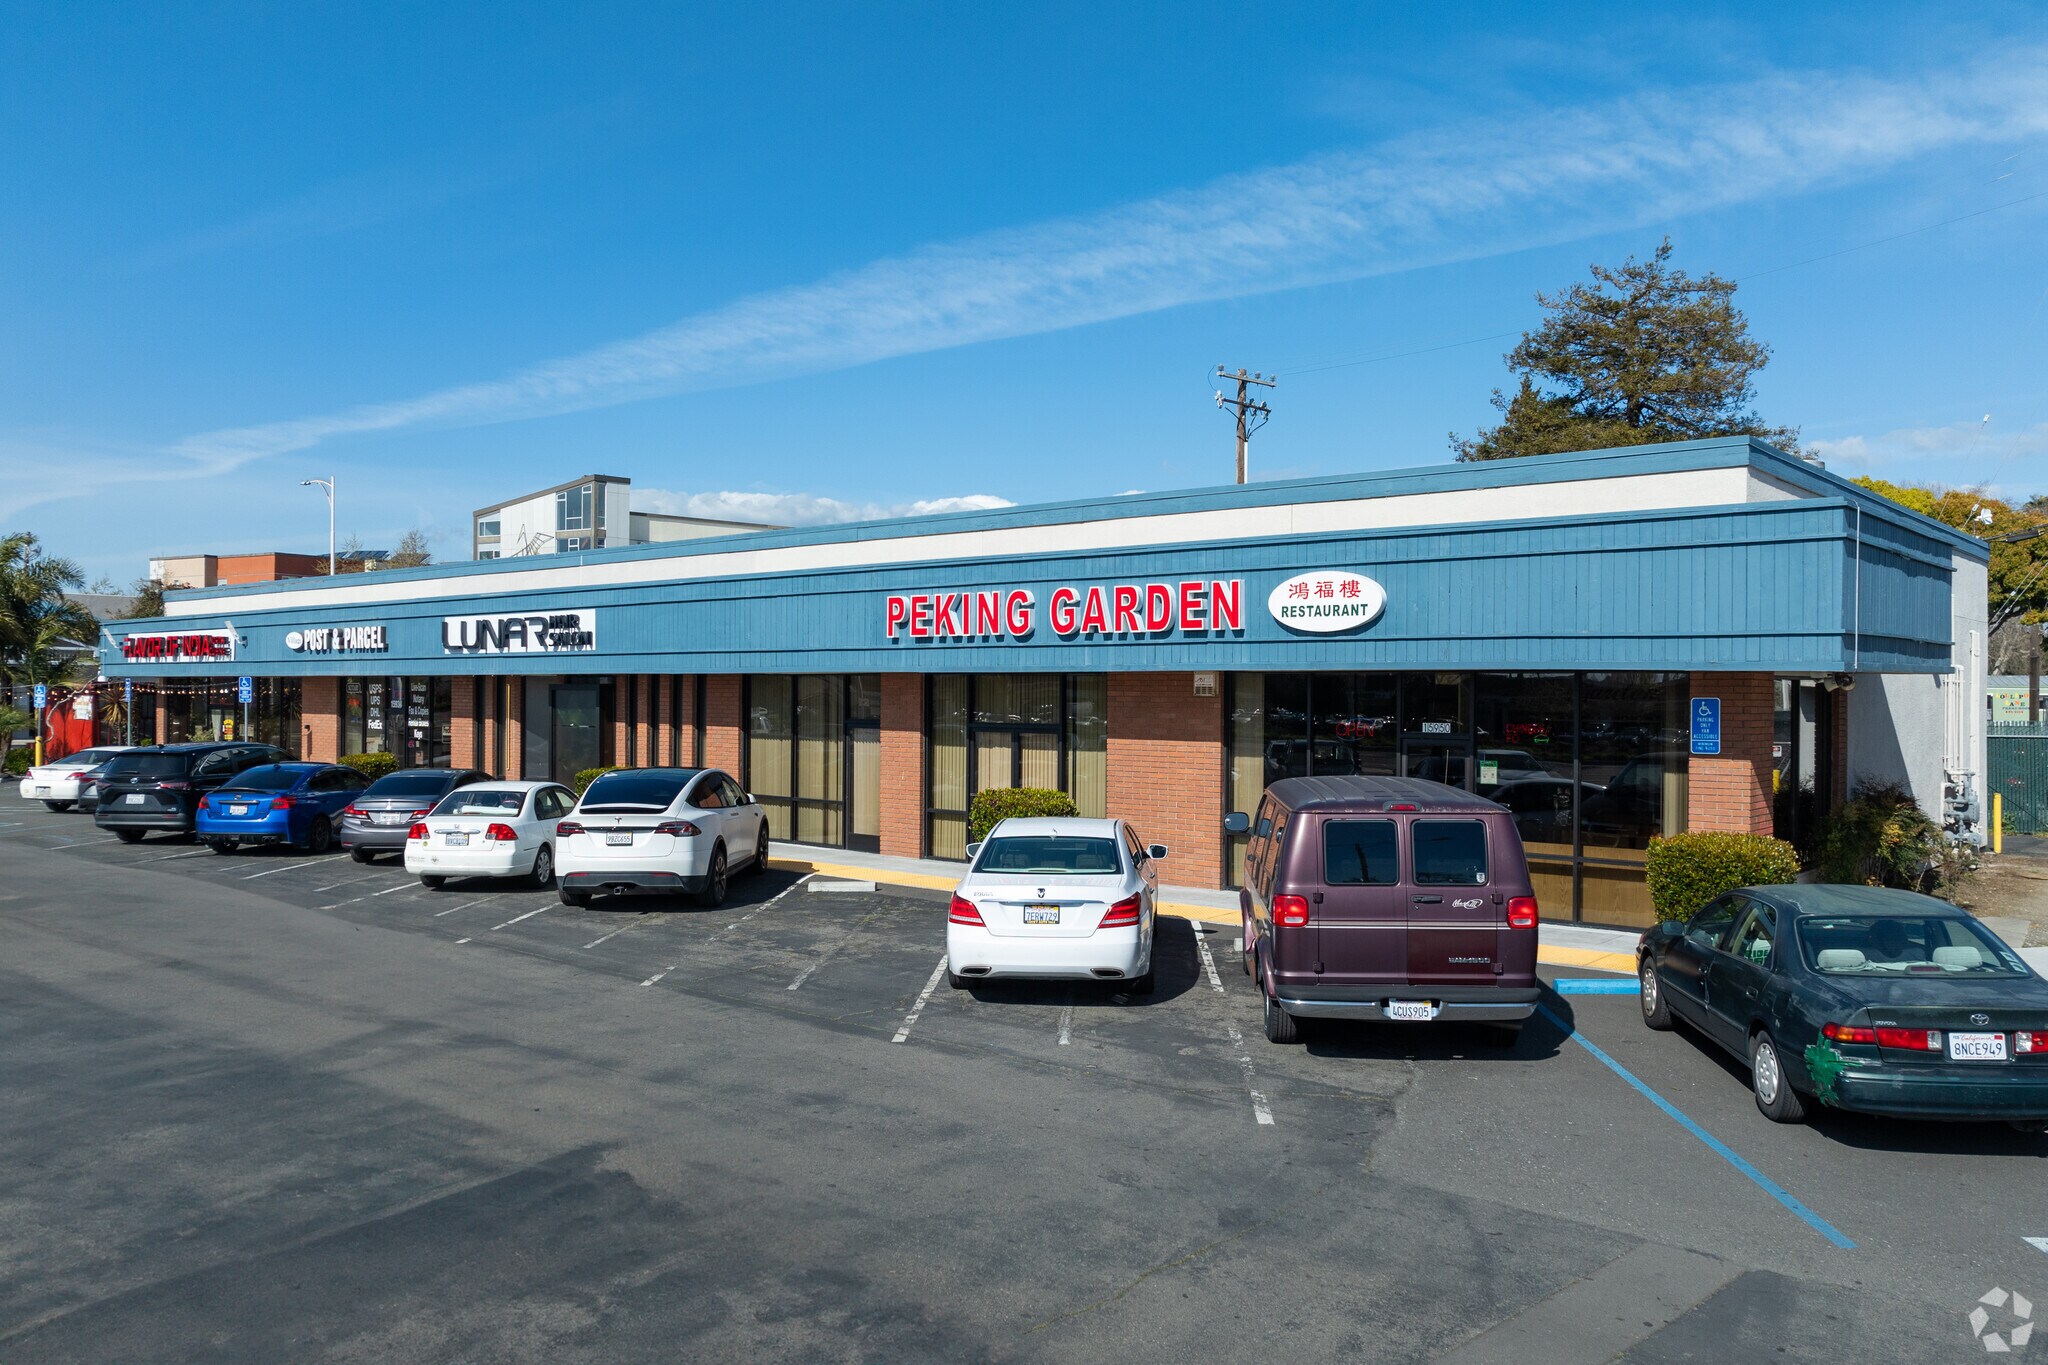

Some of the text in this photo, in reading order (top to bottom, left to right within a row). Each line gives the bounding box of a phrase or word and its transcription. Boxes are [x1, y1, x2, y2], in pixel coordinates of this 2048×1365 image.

[1289, 580, 1361, 599] 鴻福樓
[887, 580, 1244, 638] PEKING GARDEN
[1281, 604, 1368, 617] RESTAURANT
[549, 614, 580, 629] HAIR
[304, 626, 384, 650] POST & PARCEL
[442, 616, 549, 649] LUNAR
[549, 631, 593, 646] SALON
[123, 637, 162, 658] FLAVOR
[166, 636, 178, 656] OF
[369, 684, 382, 693] USPS
[370, 696, 380, 705] UPS
[370, 708, 380, 717] DHL
[368, 720, 383, 729] FedEx
[1336, 721, 1375, 736] OPEN
[1422, 723, 1450, 733] 15950
[1026, 911, 1057, 921] 7ERW729
[1393, 1006, 1429, 1017] 4CUS905
[1960, 1034, 1992, 1043] California
[1954, 1042, 2002, 1056] 8NCE949
